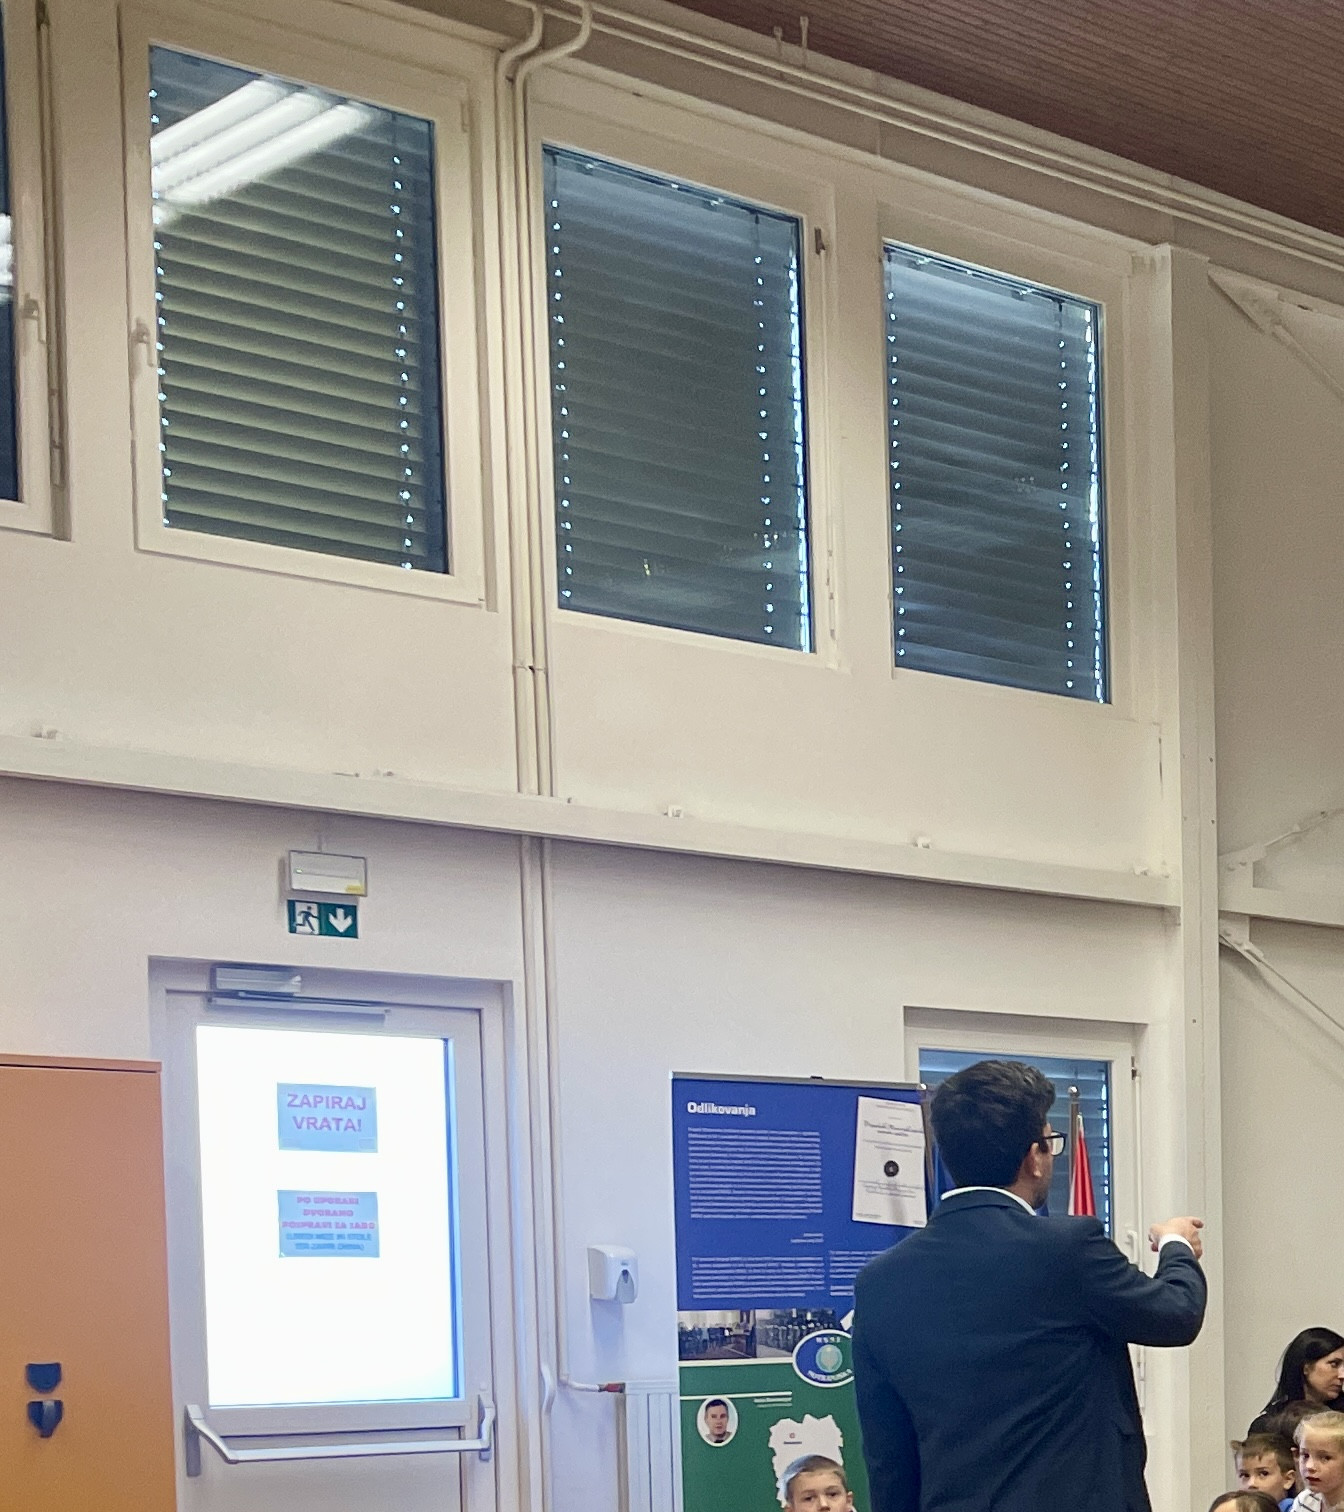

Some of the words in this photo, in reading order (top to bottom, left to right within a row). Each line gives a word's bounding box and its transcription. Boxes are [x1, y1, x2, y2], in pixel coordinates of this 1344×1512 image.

[287, 1093, 366, 1111] ZAPIRAJ
[687, 1102, 756, 1117] Odlikovanja
[292, 1116, 362, 1132] VRATA!
